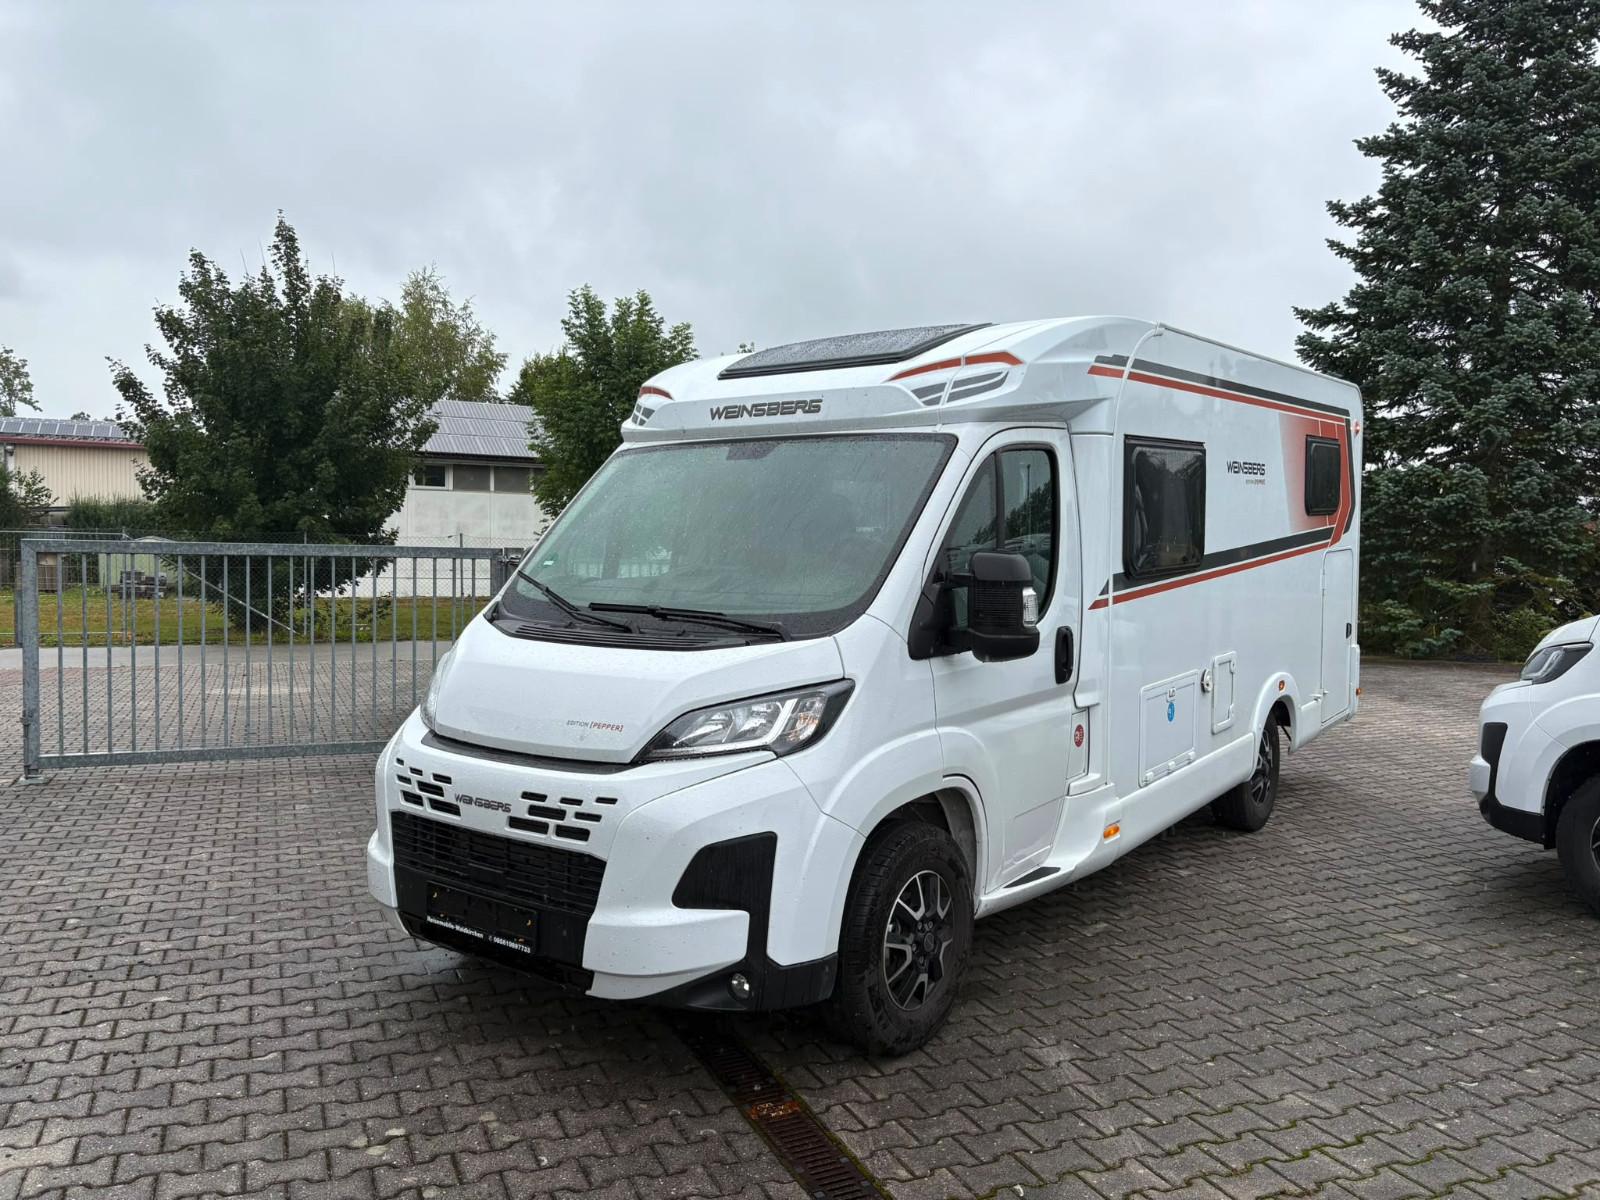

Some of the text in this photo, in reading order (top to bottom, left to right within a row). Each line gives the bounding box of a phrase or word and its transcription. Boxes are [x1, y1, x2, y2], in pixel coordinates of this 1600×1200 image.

[710, 399, 823, 421] WEINSBERG
[1226, 460, 1266, 476] WEINSBERG
[454, 793, 512, 813] WEINSBERG
